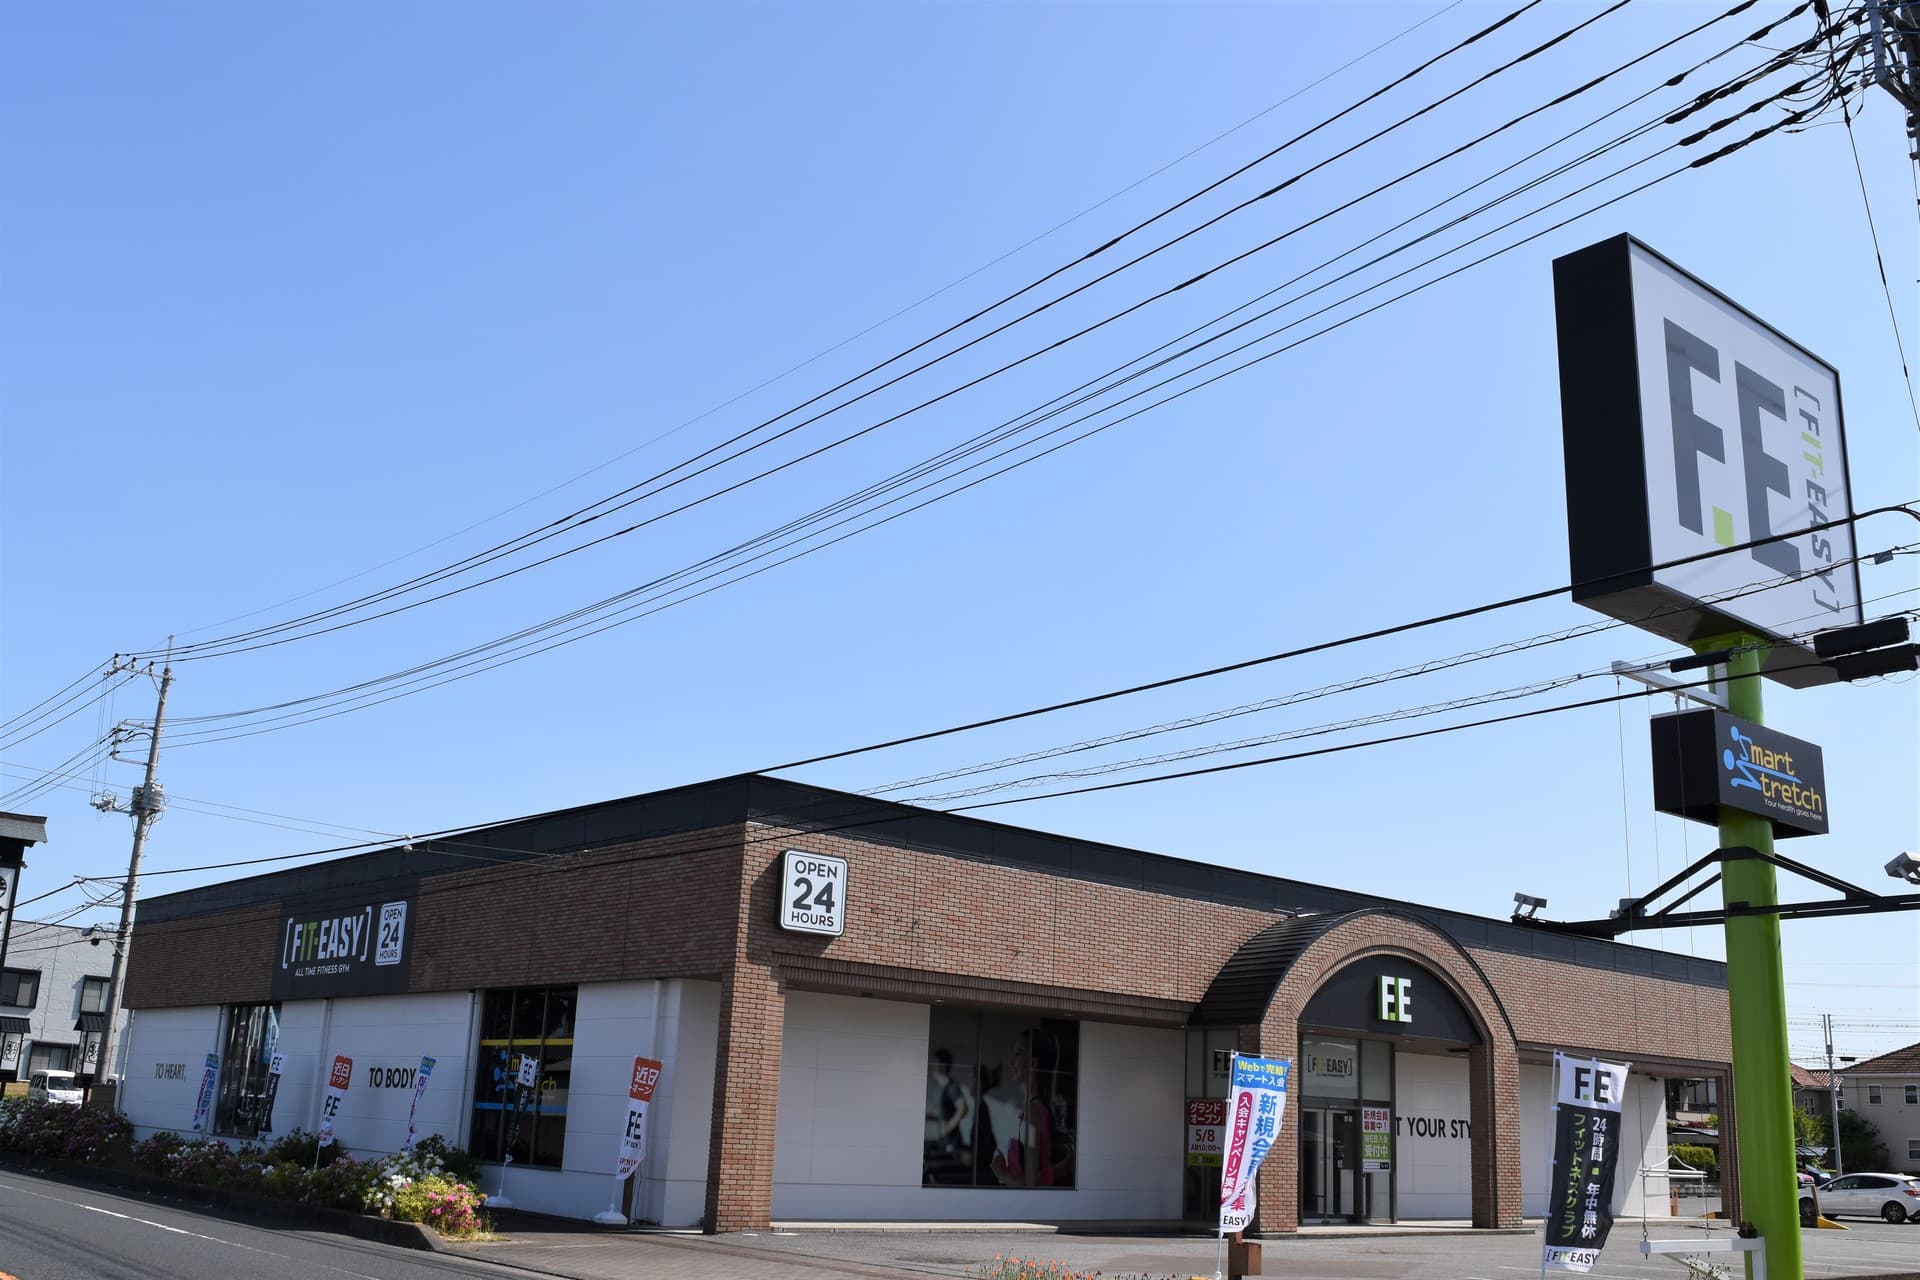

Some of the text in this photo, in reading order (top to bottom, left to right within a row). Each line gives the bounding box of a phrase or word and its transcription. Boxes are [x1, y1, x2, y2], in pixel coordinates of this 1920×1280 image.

[794, 860, 838, 879] OPEN
[792, 877, 836, 914] 24
[384, 908, 402, 920] OPEN
[791, 911, 834, 927] HOURS
[380, 921, 400, 949] 24
[379, 949, 398, 960] HOURS
[294, 963, 350, 977] ALL TIME FITNESS GYM
[154, 1063, 165, 1079] TO
[369, 1067, 383, 1088] TO
[634, 1065, 659, 1086] 近日
[1236, 1072, 1285, 1088] スマート入会
[1190, 1102, 1221, 1113] グランド
[1190, 1114, 1221, 1124] オープン
[1195, 1129, 1216, 1142] 5/8
[1406, 1117, 1447, 1138] YOUR
[1561, 1113, 1586, 1238] フィットネスクラブ
[1581, 1182, 1600, 1239] 年中無休
